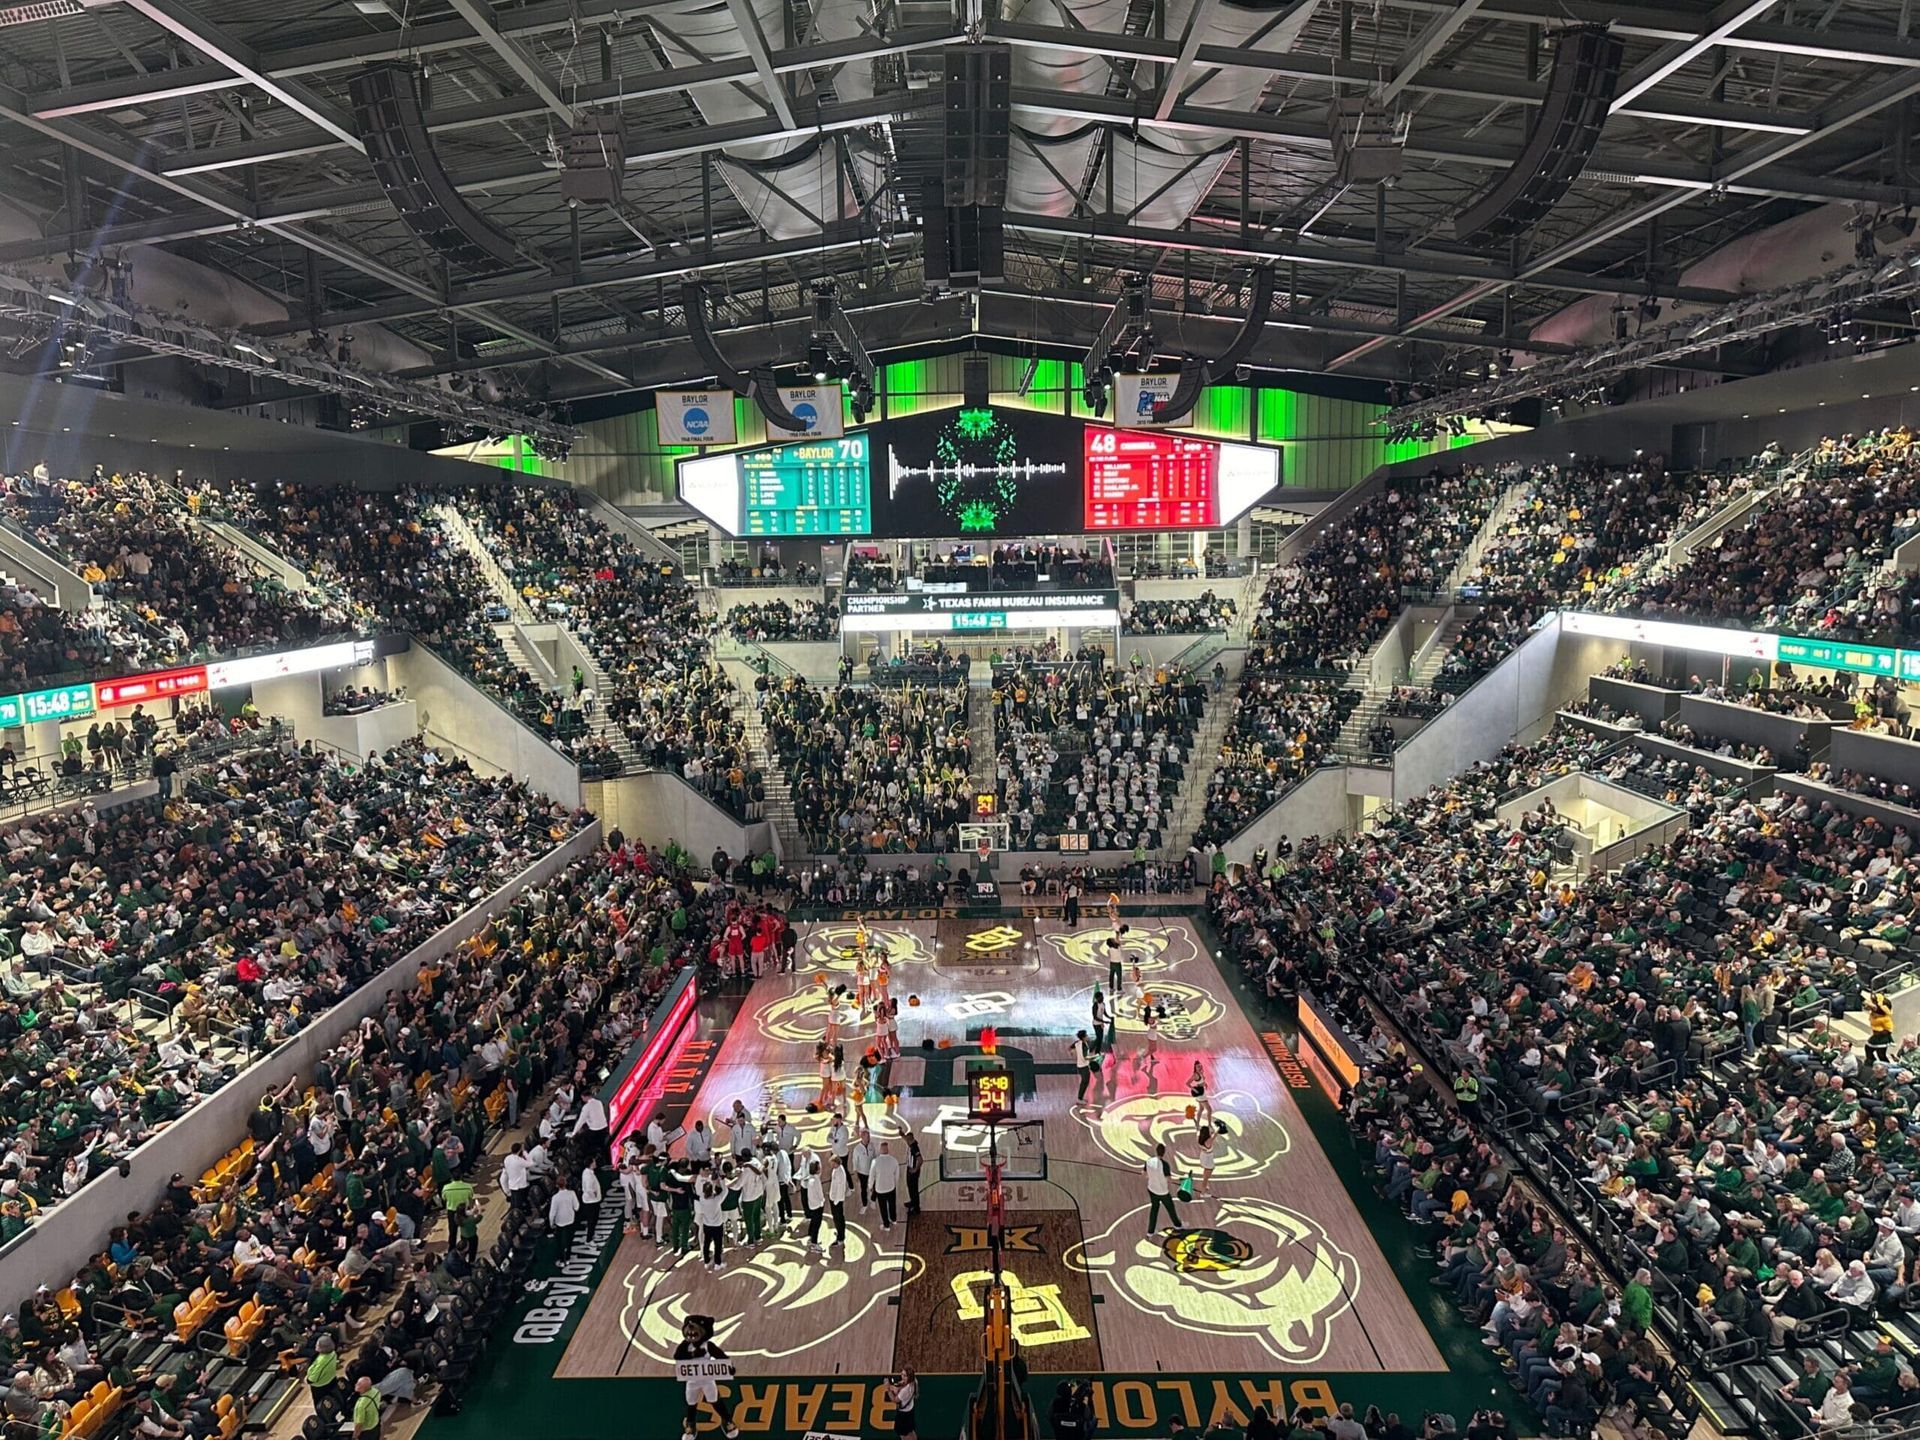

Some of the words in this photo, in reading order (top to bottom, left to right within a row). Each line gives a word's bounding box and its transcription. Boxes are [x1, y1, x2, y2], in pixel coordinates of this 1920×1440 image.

[1141, 378, 1167, 386] BAYLOR
[682, 395, 708, 403] BAYLOR
[790, 390, 816, 398] BAYLOR
[686, 420, 708, 428] NCAA
[798, 447, 834, 459] BAYLOR
[838, 440, 862, 459] 70
[1090, 434, 1116, 453] 48
[847, 596, 909, 604] CHAMPIONSHIP
[938, 598, 972, 608] TEXAS
[972, 598, 1000, 607] FARM
[1002, 596, 1043, 606] BUREAU
[1044, 594, 1104, 605] INSURANCE
[848, 604, 886, 612] PARTNER
[954, 616, 987, 627] 15:48
[1878, 654, 1892, 669] 70
[1, 703, 16, 718] 70
[27, 692, 70, 718] 15:48
[100, 688, 114, 702] 48
[976, 882, 994, 893] TNB
[842, 908, 958, 920] BAYLOR
[1022, 907, 1120, 918] BERS
[1278, 1061, 1312, 1088] FOSTER
[980, 1076, 1008, 1090] 15:48
[979, 1090, 1005, 1112] 24
[680, 1364, 699, 1376] GET
[702, 1362, 728, 1376] LOUD
